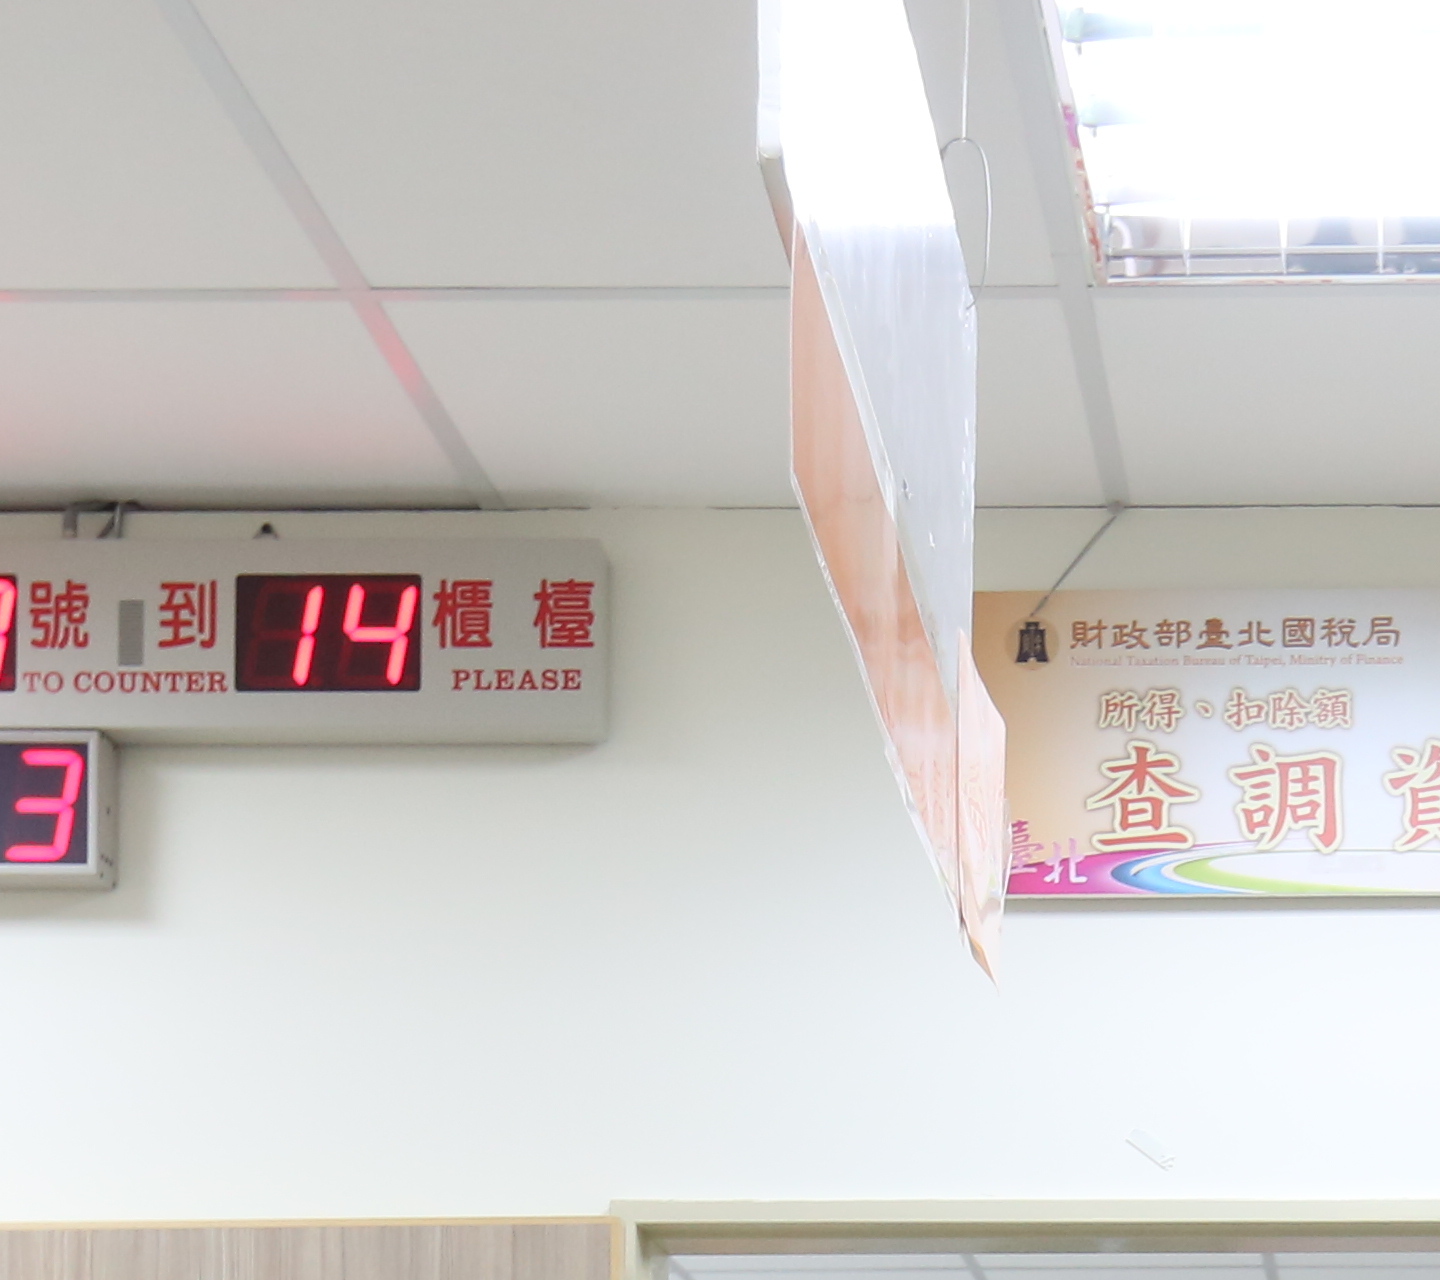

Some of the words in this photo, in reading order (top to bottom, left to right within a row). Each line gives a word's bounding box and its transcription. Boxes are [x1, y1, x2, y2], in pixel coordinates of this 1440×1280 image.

[28, 581, 88, 650] 號
[158, 581, 217, 650] 到
[292, 583, 418, 687] 14
[1070, 617, 1401, 650] 財政部臺北國稅局
[1070, 655, 1122, 667] National
[1127, 655, 1179, 667] Taxation
[1183, 655, 1225, 667] Bureau
[1230, 654, 1242, 667] of
[1340, 653, 1354, 666] of
[1356, 654, 1404, 666] Finance
[24, 671, 67, 696] TO
[71, 671, 229, 697] COUNTER
[450, 668, 583, 692] PLEASE
[1100, 688, 1353, 733] 所得、扣除額
[6, 747, 83, 864] 3
